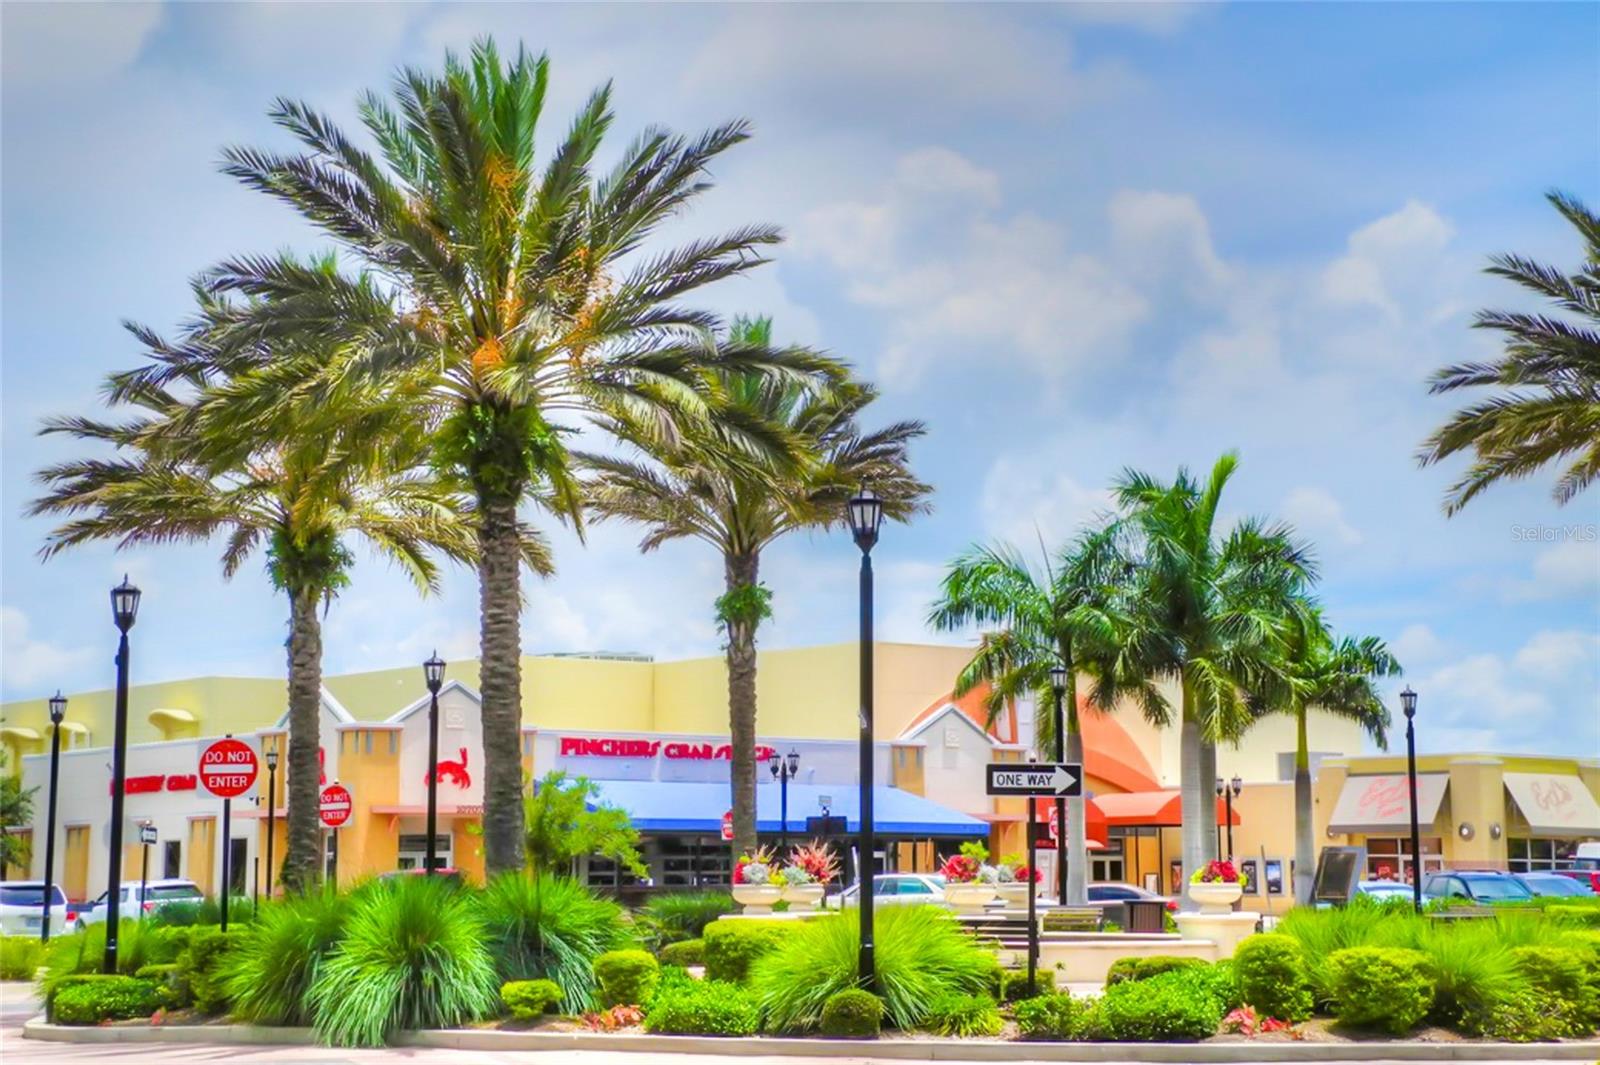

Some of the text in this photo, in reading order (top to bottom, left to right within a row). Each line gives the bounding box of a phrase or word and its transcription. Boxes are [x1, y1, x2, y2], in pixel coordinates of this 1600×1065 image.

[205, 751, 251, 763] DO NOT
[664, 743, 713, 760] CRAB
[209, 776, 248, 788] ENTER
[996, 774, 1053, 786] ONE WAY
[320, 792, 348, 803] DO NOT
[323, 810, 347, 820] ENTER
